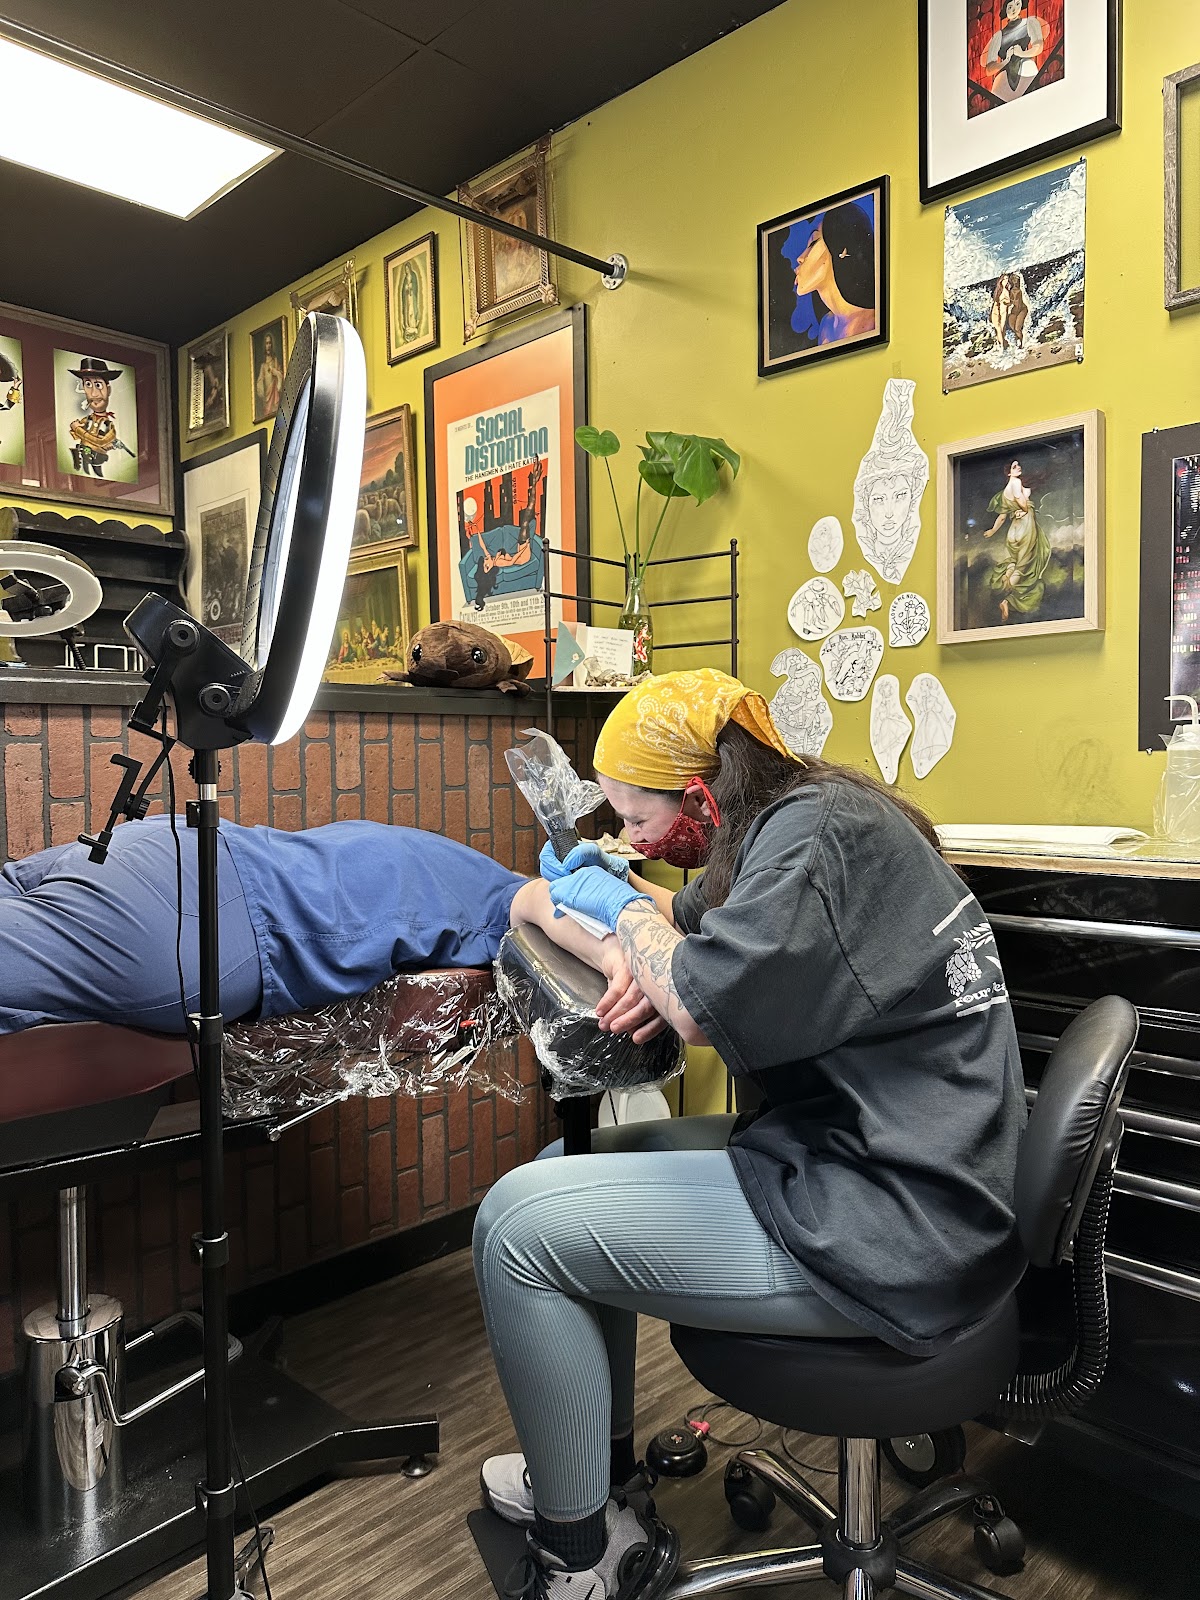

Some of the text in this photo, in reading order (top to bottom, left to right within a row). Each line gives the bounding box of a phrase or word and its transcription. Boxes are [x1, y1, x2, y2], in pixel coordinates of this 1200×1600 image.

[476, 407, 525, 446] SOCIAL
[465, 427, 548, 475] DISTORTION
[474, 467, 499, 480] HANGMEN
[508, 461, 521, 470] HATE
